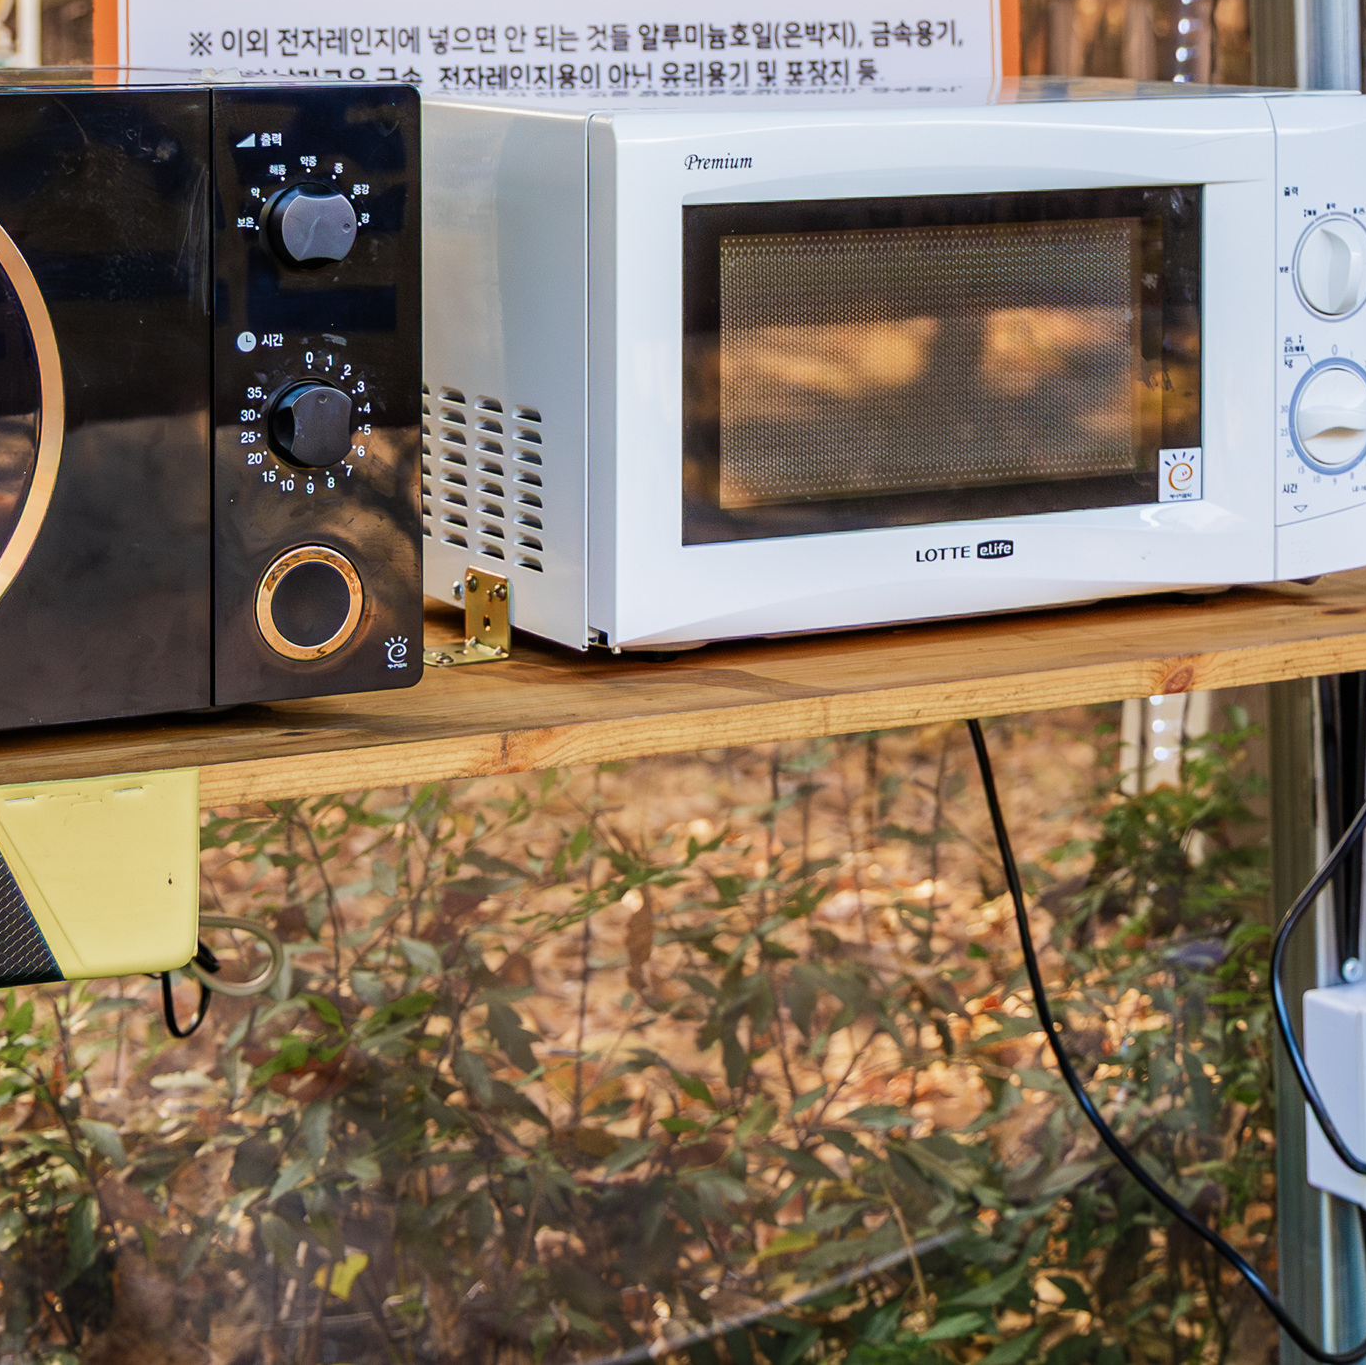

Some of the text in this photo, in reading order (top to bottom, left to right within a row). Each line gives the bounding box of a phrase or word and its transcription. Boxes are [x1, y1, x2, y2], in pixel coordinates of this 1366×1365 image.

[221, 19, 963, 58] 이외 전자레인지에 넣으면 안 되는 것들 알루미늄호일(은박지), 금속용기,
[260, 132, 282, 147] 출력
[684, 152, 753, 171] Premium
[361, 212, 370, 224] 강
[261, 333, 284, 347] 시간
[305, 352, 314, 364] 0
[327, 354, 333, 366] 1
[343, 364, 352, 376] 2
[247, 387, 262, 399] 35
[357, 381, 365, 393] 3
[363, 402, 371, 414] 4
[240, 409, 256, 421] 30
[363, 424, 372, 436] 5
[240, 432, 256, 443] 25
[357, 446, 365, 457] 6
[247, 453, 262, 465] 20
[262, 471, 276, 482] 15
[345, 465, 353, 477] 7
[280, 480, 294, 491] 10
[306, 482, 315, 494] 9
[327, 477, 335, 488] 8
[916, 545, 971, 563] LOTTE
